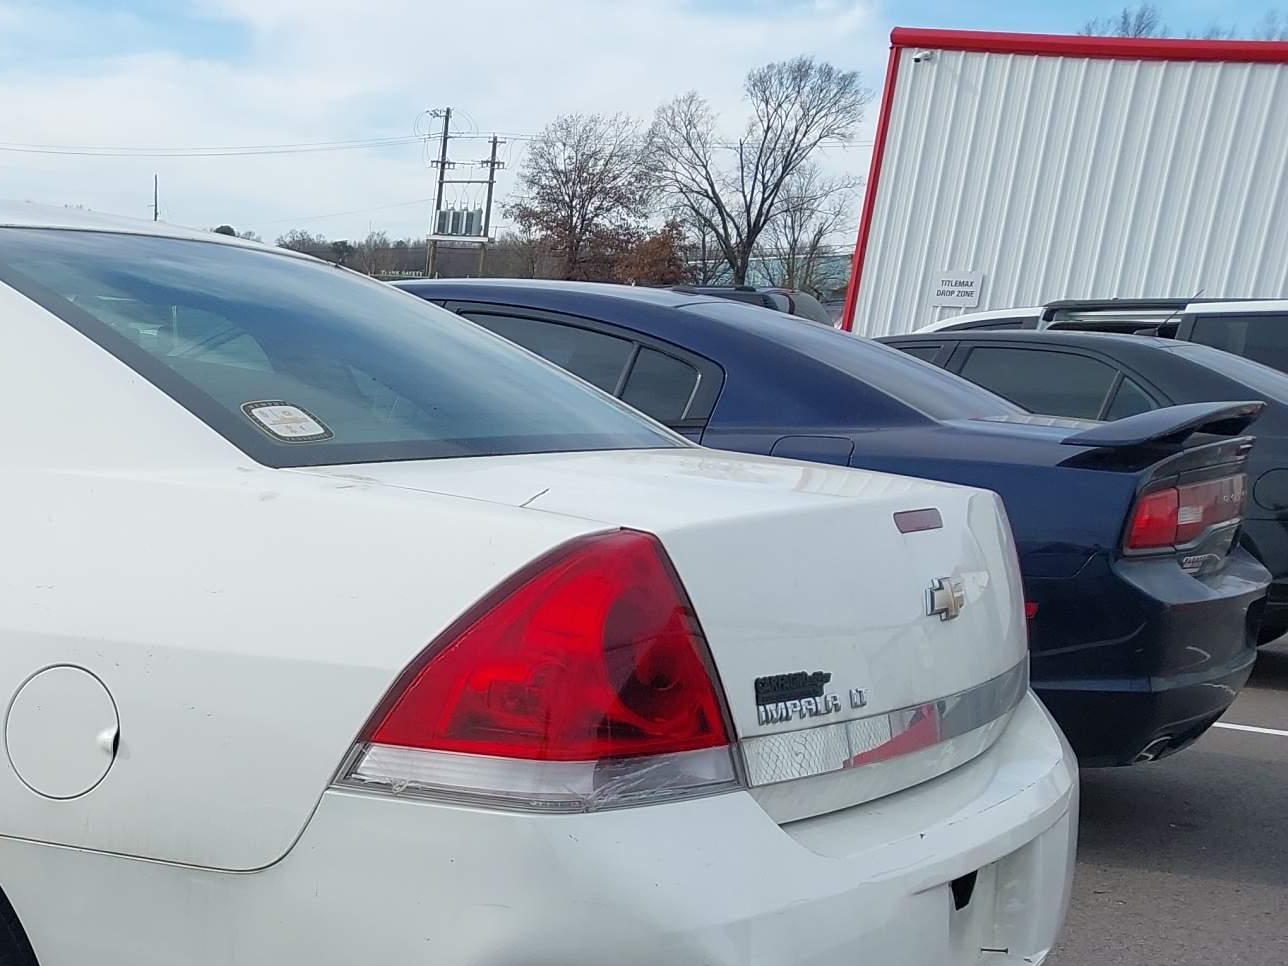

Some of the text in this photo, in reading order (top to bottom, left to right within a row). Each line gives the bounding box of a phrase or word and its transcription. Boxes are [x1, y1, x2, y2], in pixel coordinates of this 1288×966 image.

[941, 279, 974, 287] TITLEMAX
[936, 289, 975, 298] DROP ZONE
[757, 694, 842, 726] IMPALA
